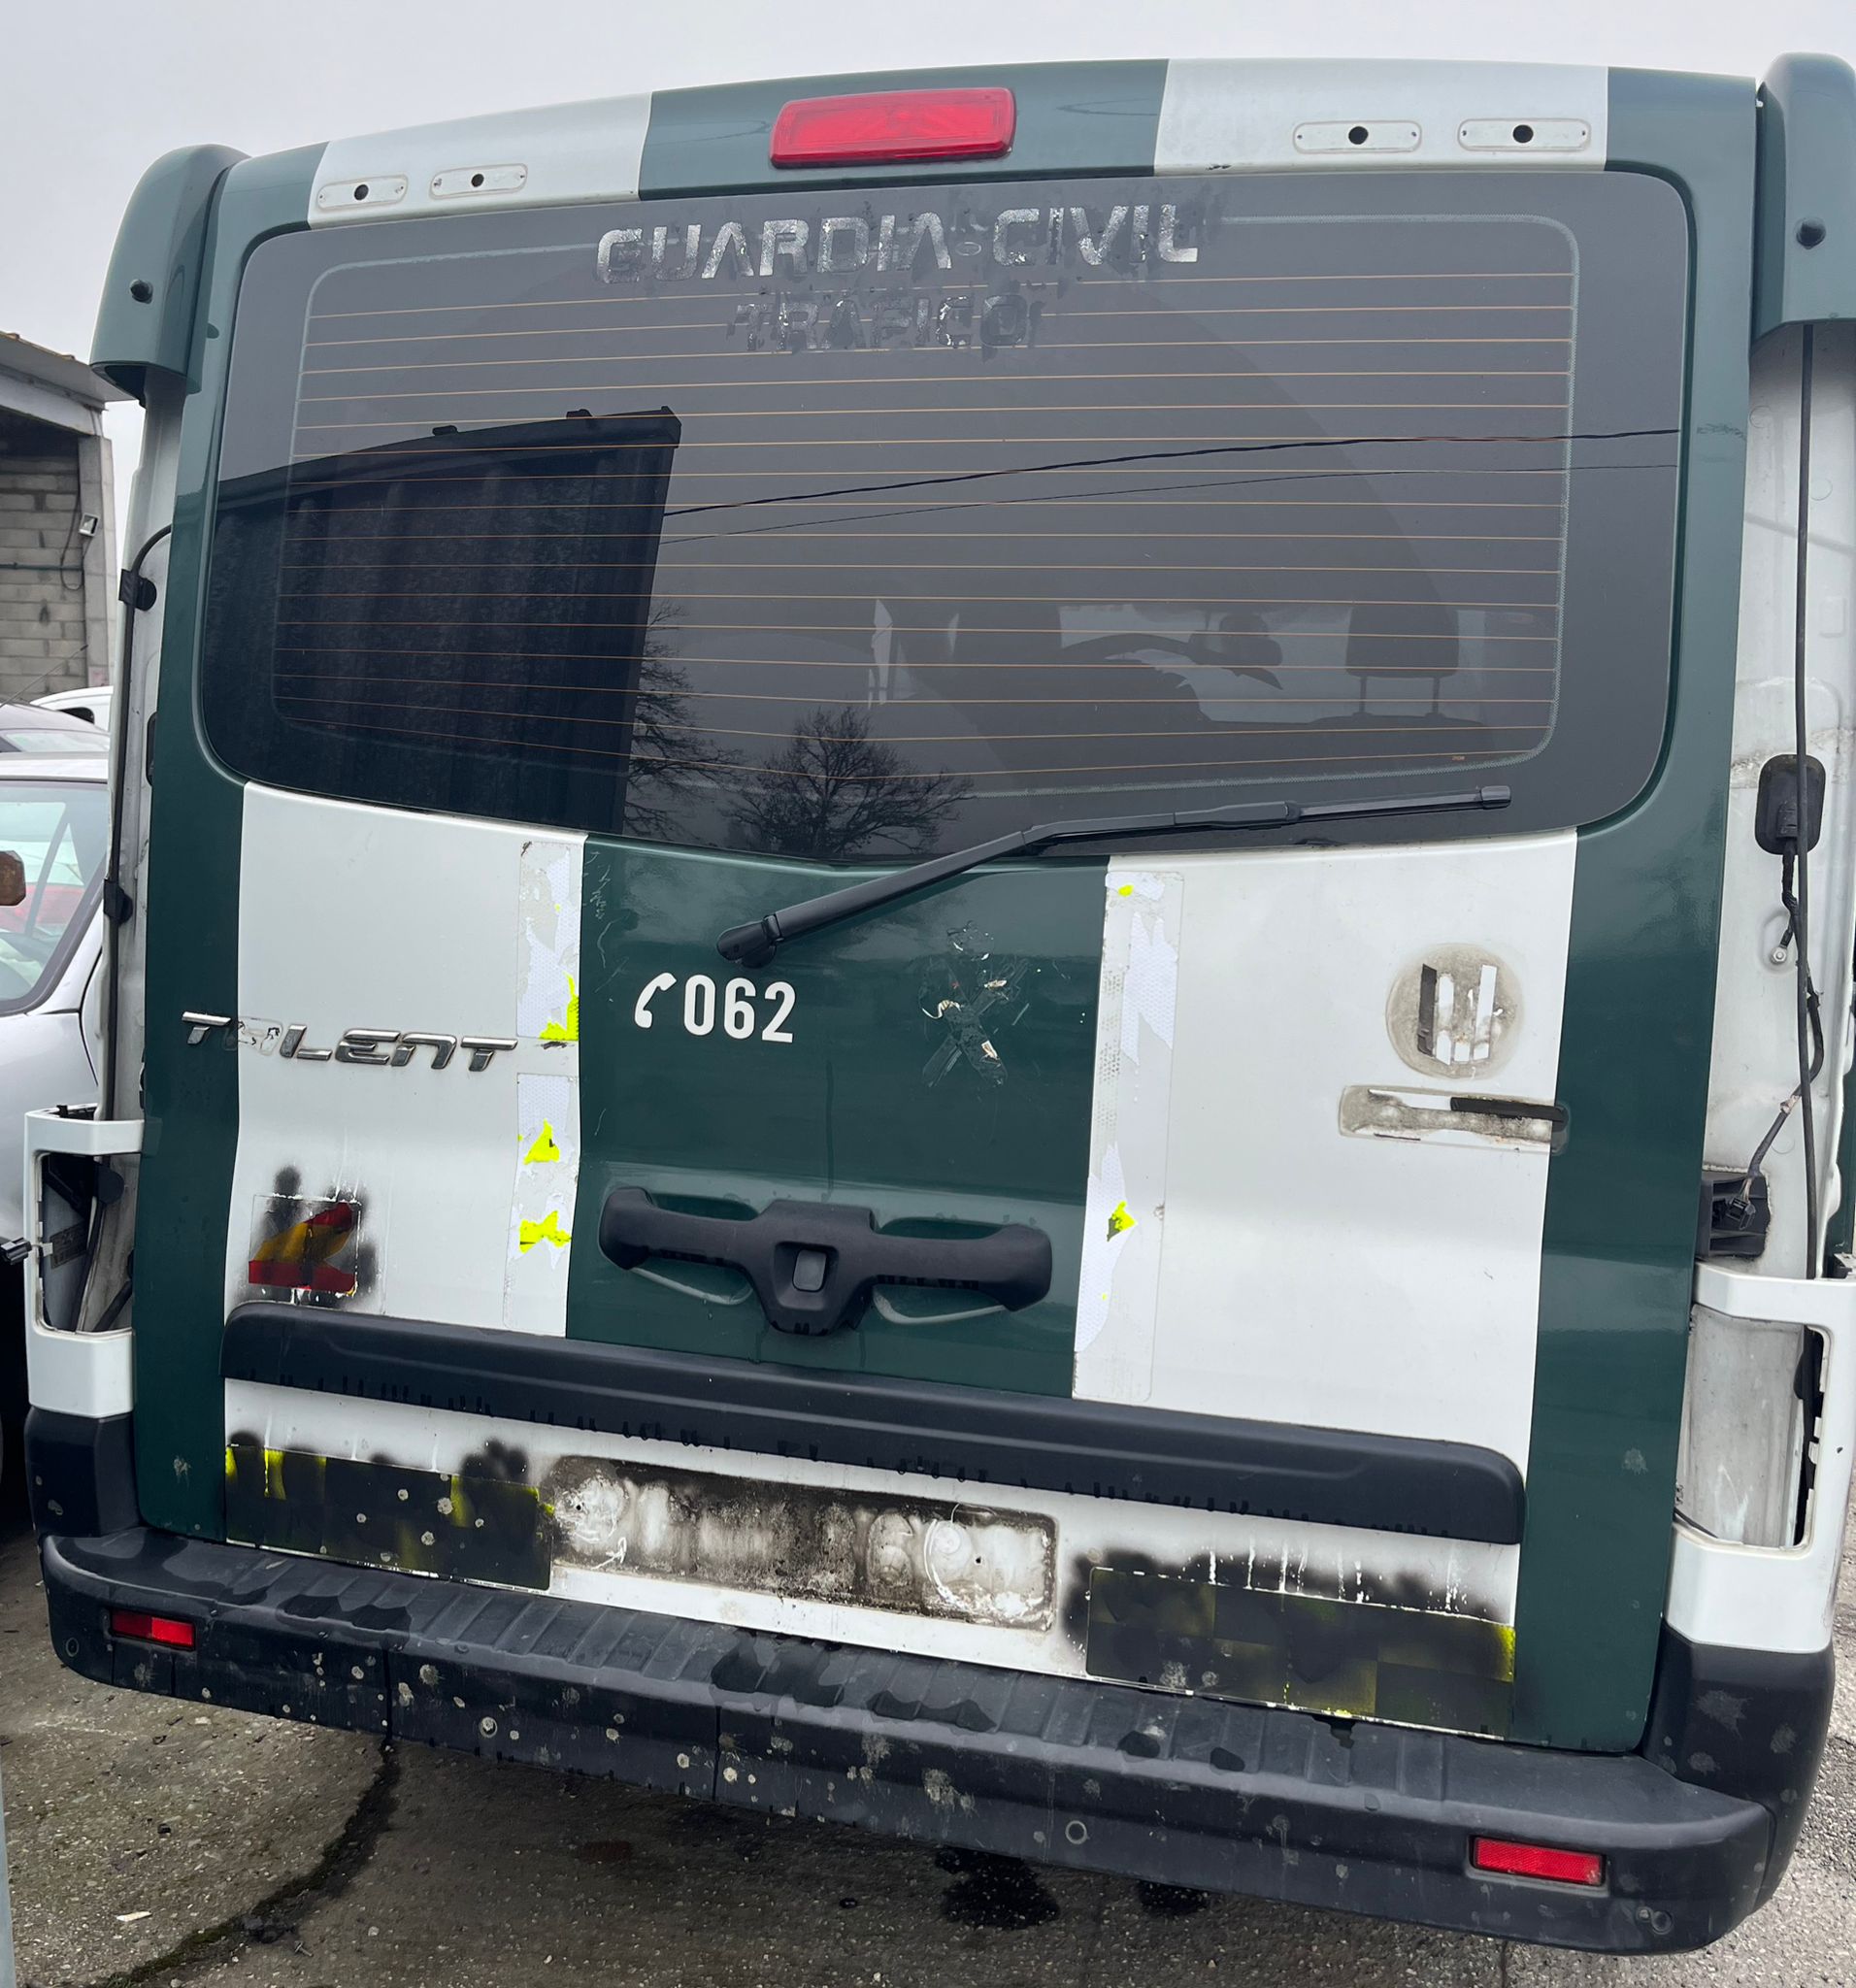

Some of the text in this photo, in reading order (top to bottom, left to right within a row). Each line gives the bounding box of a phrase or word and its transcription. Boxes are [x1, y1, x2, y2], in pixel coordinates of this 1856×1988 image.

[596, 203, 1199, 284] GUARDIA CIVIL
[181, 1010, 519, 1073] TLENT
[683, 974, 796, 1044] 062
